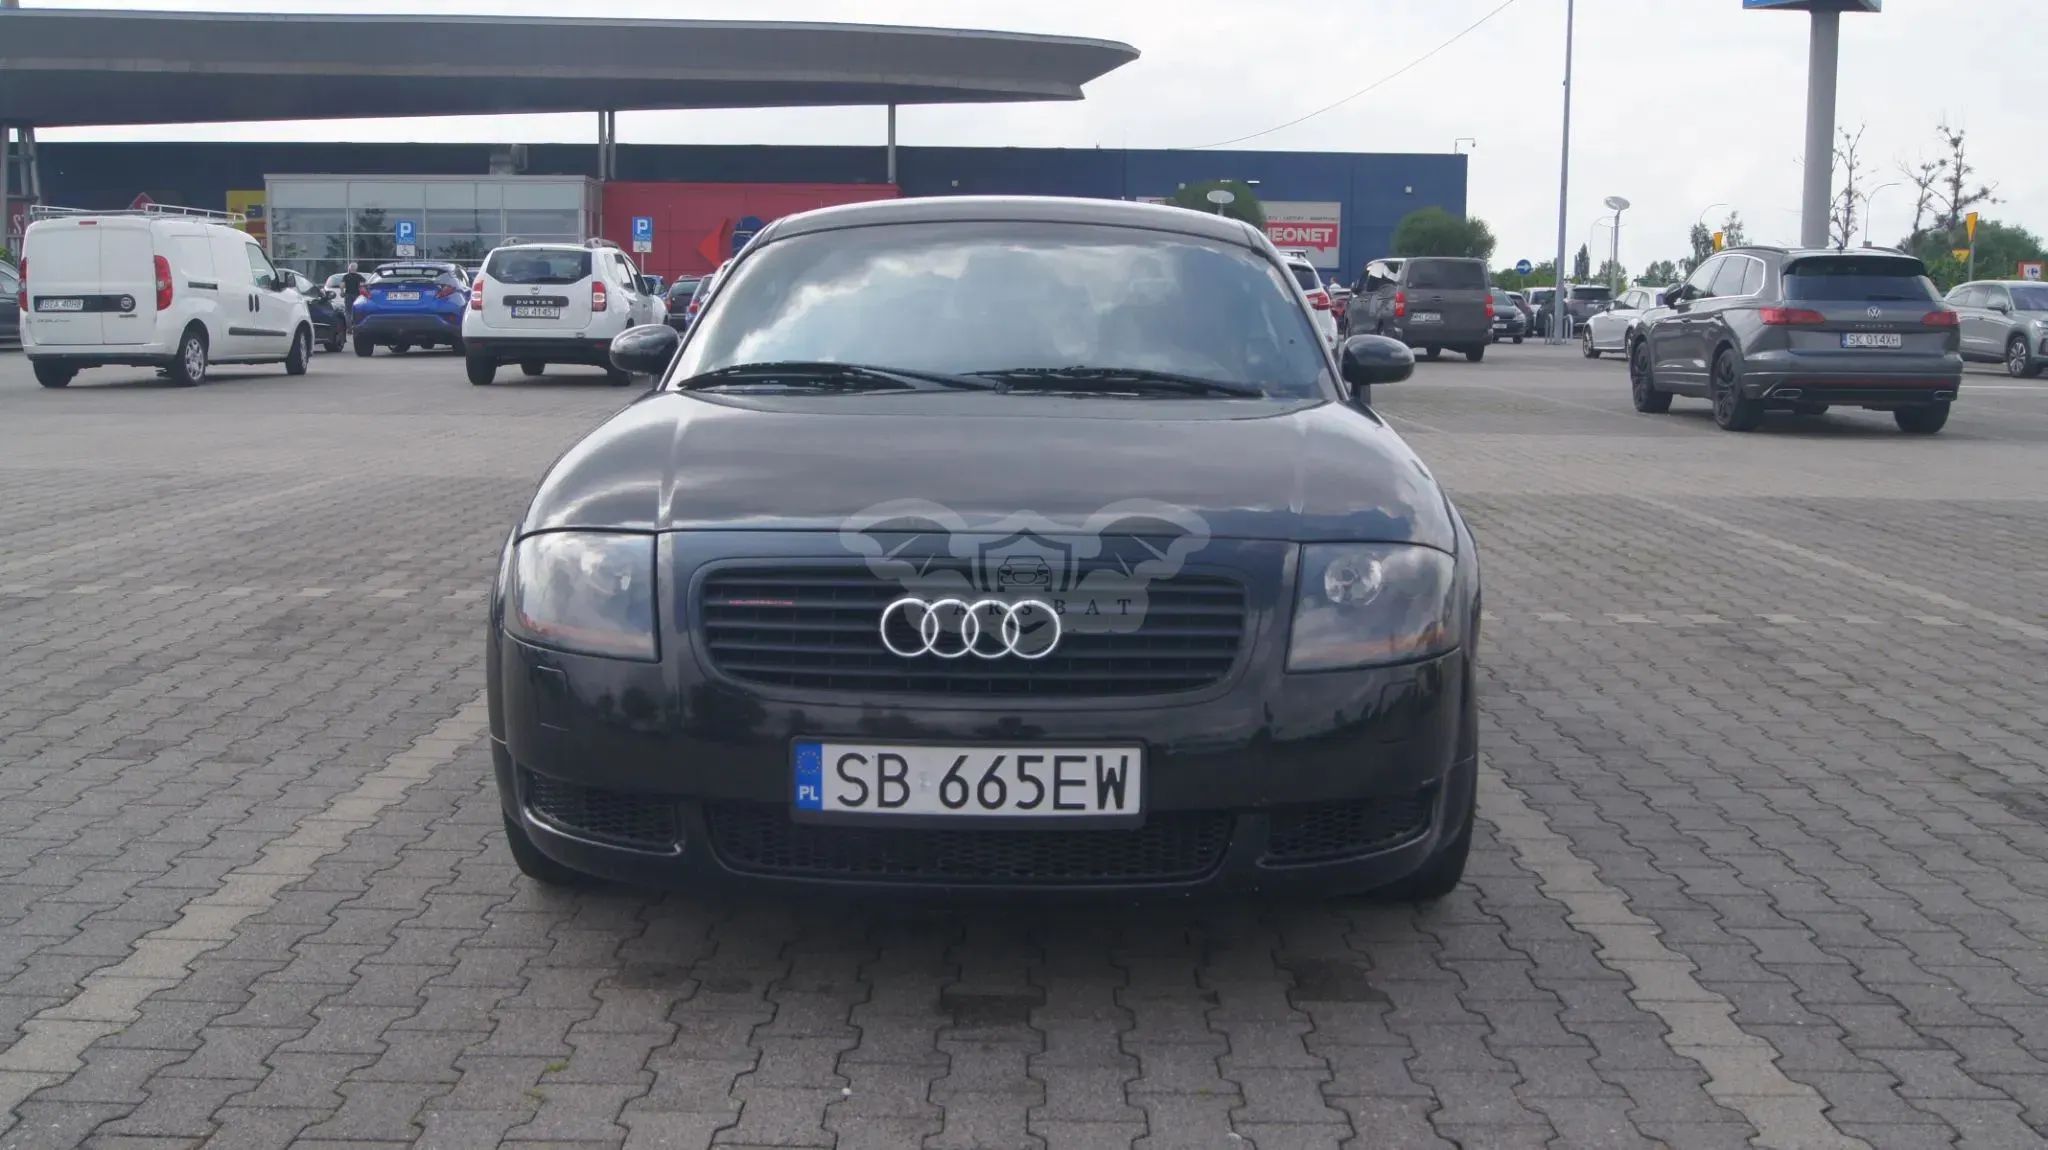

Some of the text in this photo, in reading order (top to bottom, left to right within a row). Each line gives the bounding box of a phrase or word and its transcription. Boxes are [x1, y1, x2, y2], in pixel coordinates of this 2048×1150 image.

[400, 222, 412, 238] P
[637, 219, 648, 234] P
[1848, 334, 1864, 345] SK
[836, 752, 1129, 810] SB 665EW
[799, 785, 819, 801] PL
